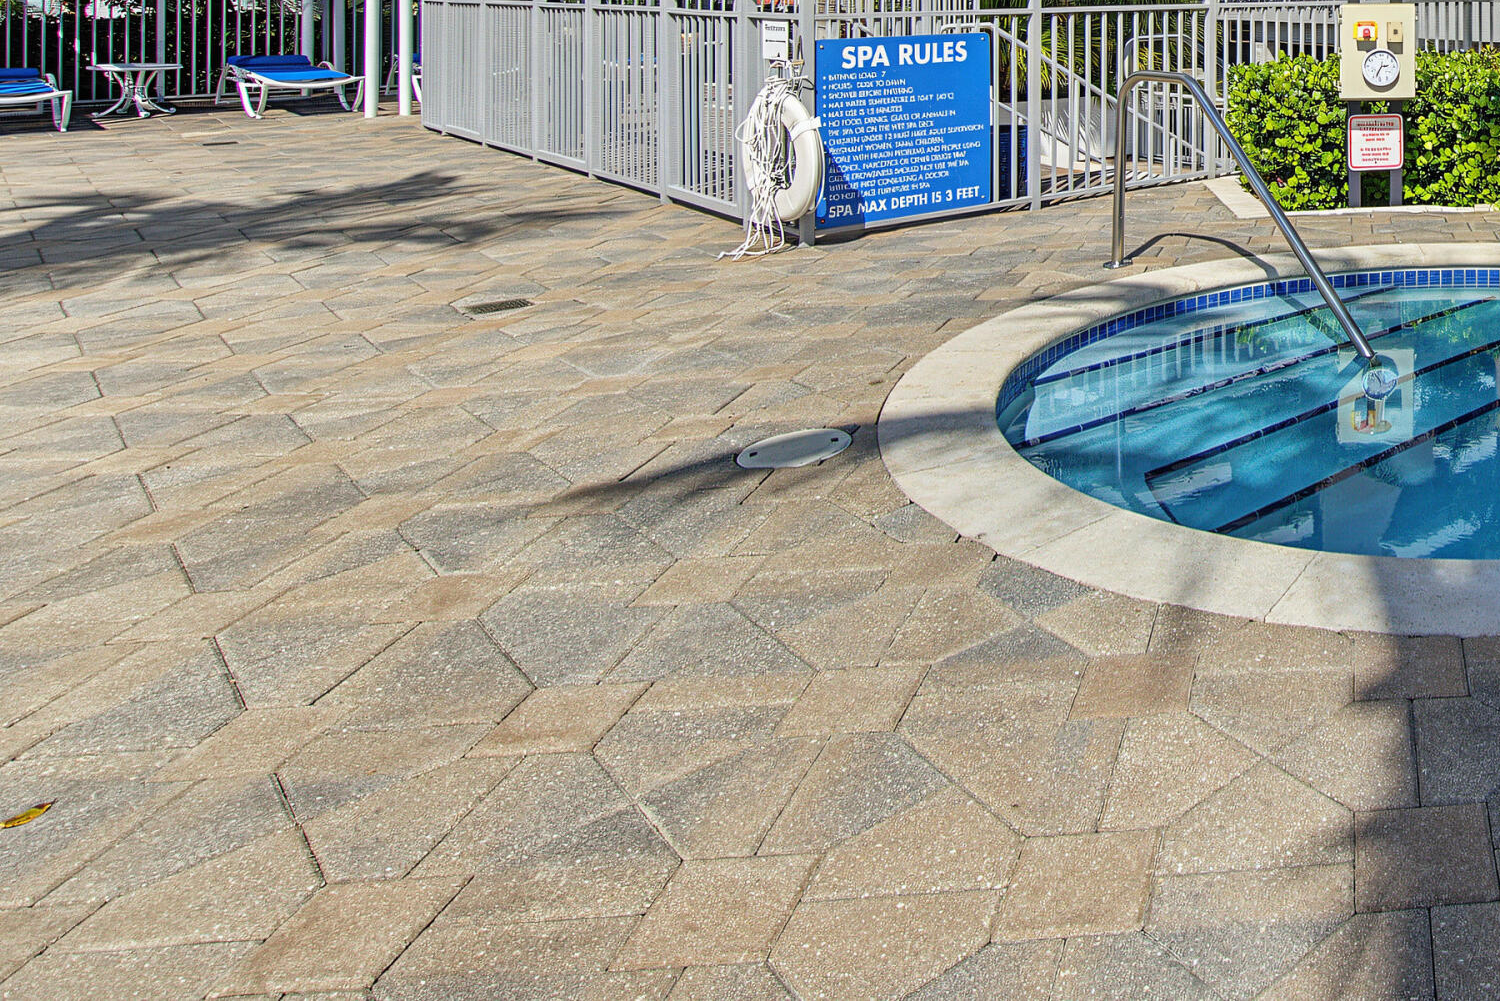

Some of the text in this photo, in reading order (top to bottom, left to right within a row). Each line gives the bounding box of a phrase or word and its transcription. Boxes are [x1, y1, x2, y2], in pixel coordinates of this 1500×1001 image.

[841, 41, 967, 68] SPA RULES
[828, 185, 979, 218] SPA MAX DEPTH IS 3 FEET
